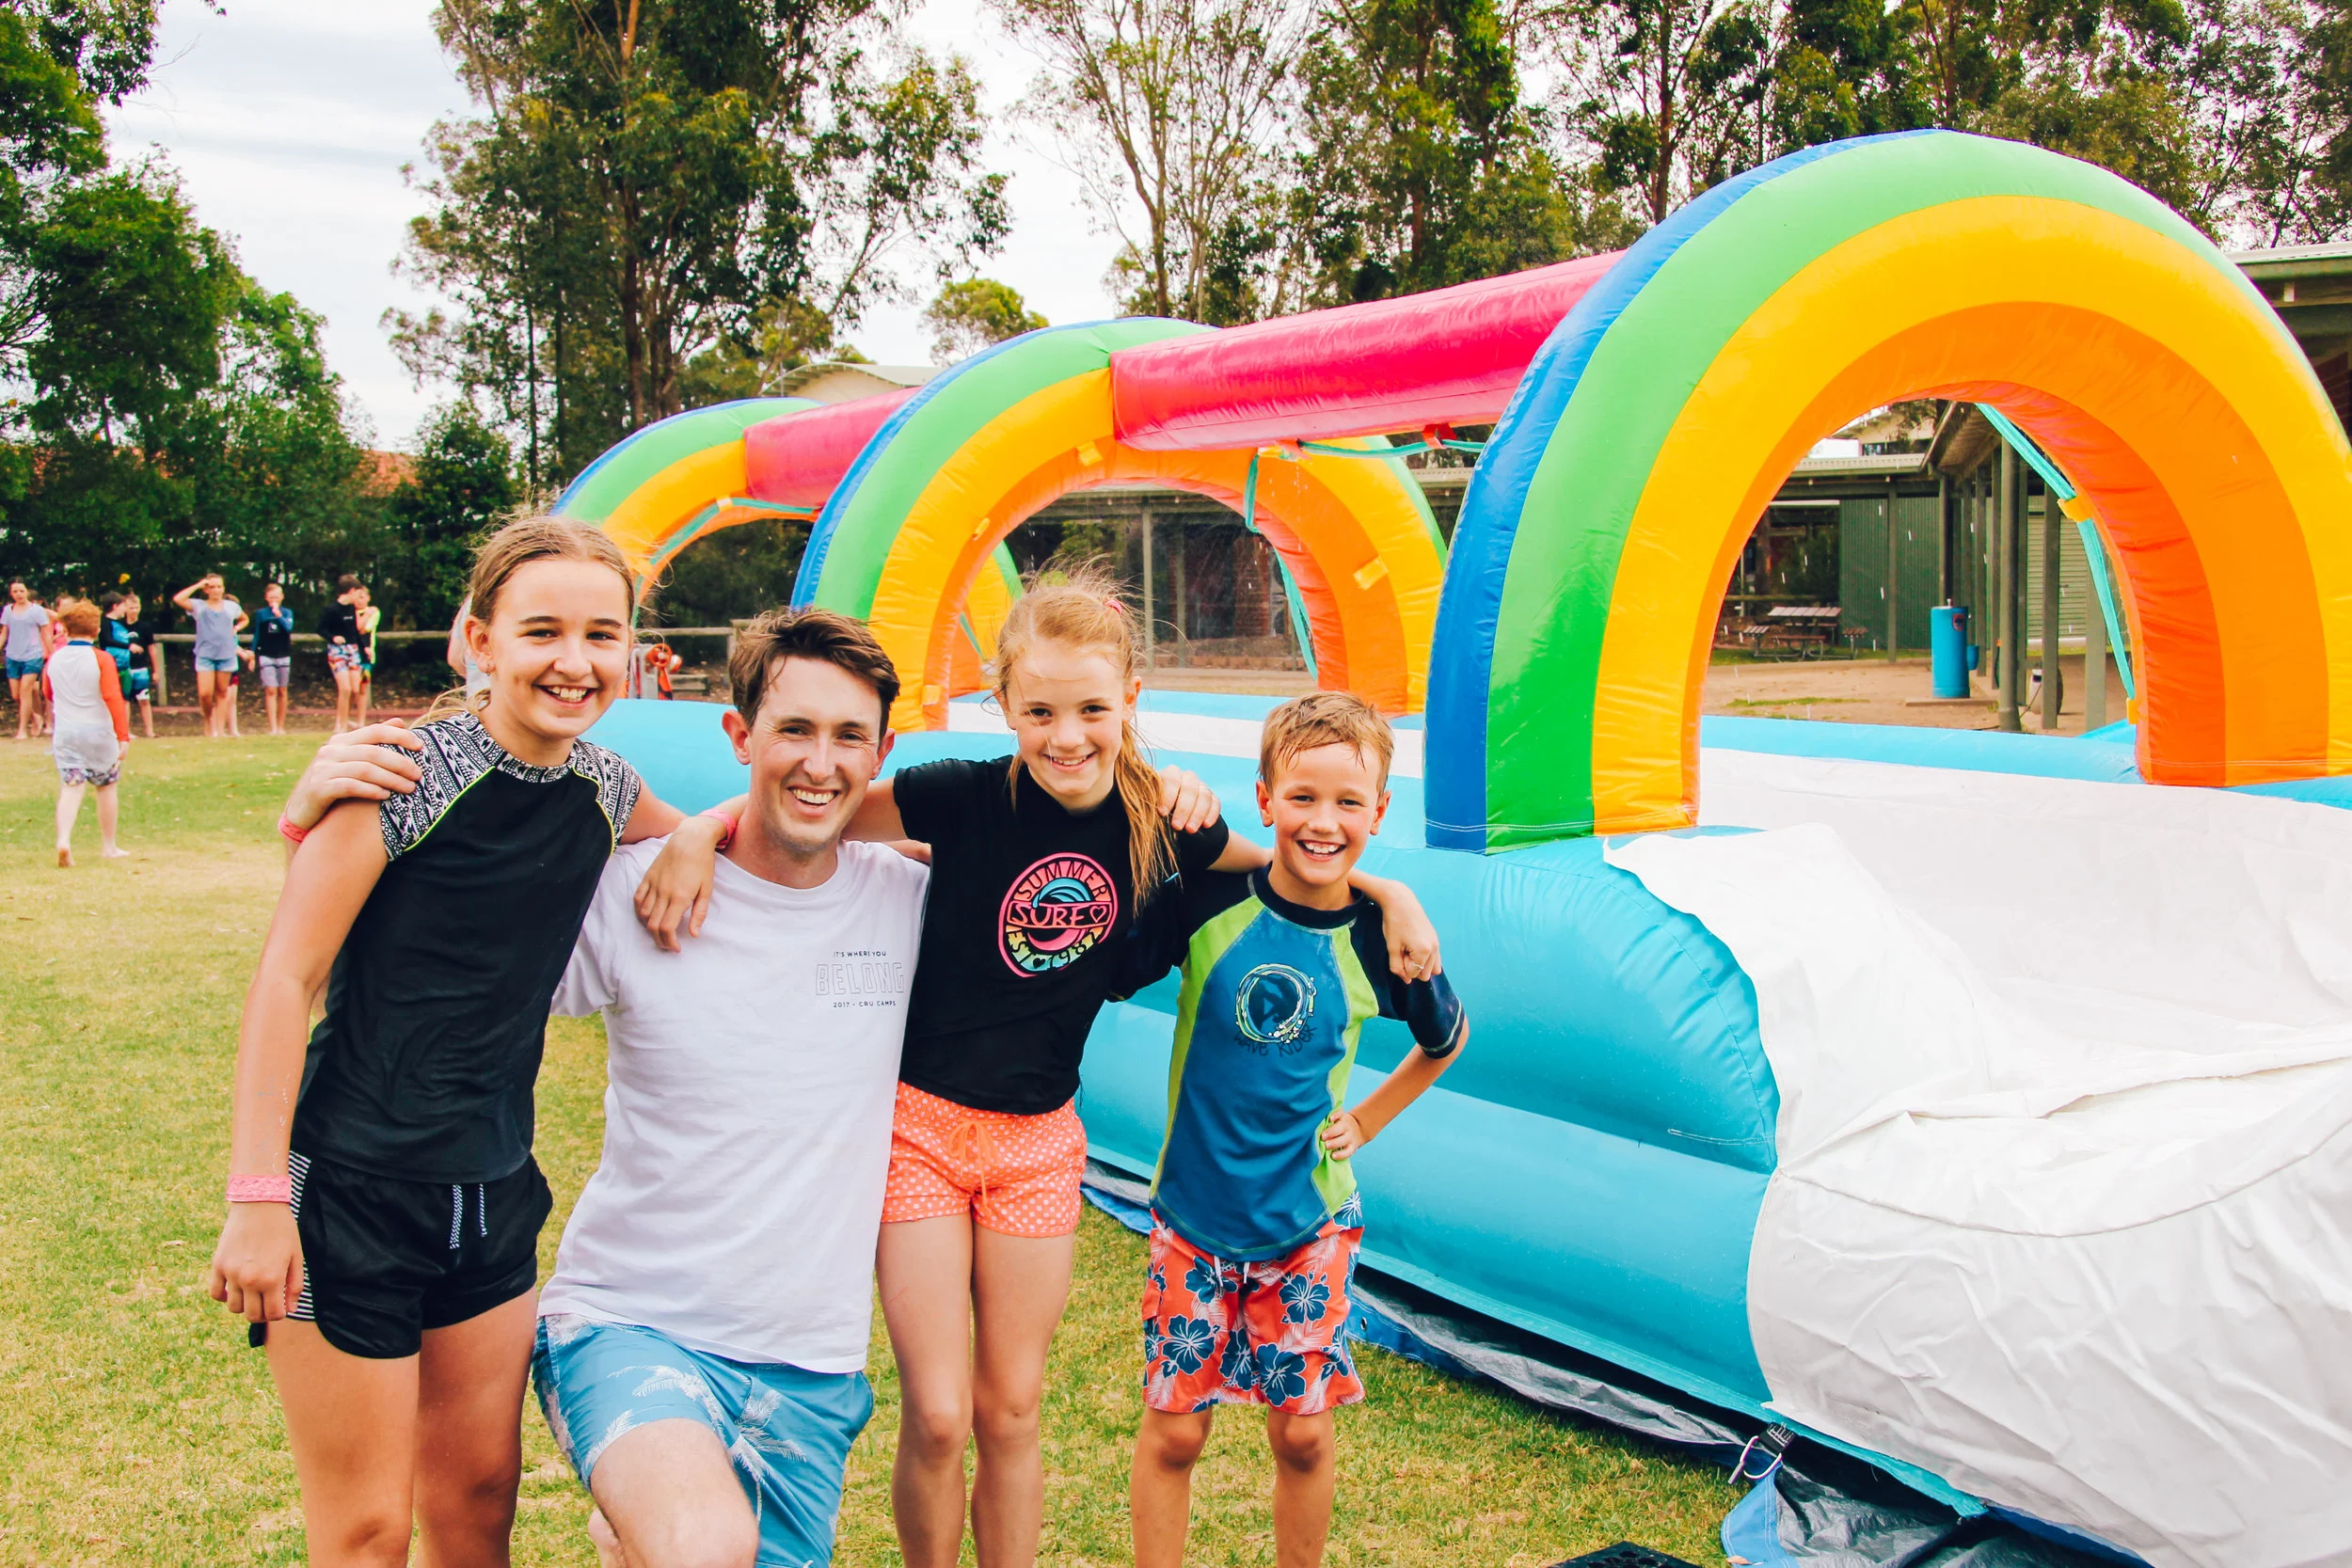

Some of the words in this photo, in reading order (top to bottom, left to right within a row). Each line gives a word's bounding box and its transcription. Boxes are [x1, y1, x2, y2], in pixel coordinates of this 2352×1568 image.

[1016, 860, 1110, 901] SUMMER
[1011, 902, 1085, 927] SURF
[1048, 928, 1099, 970] 1987
[815, 961, 904, 996] BELONG
